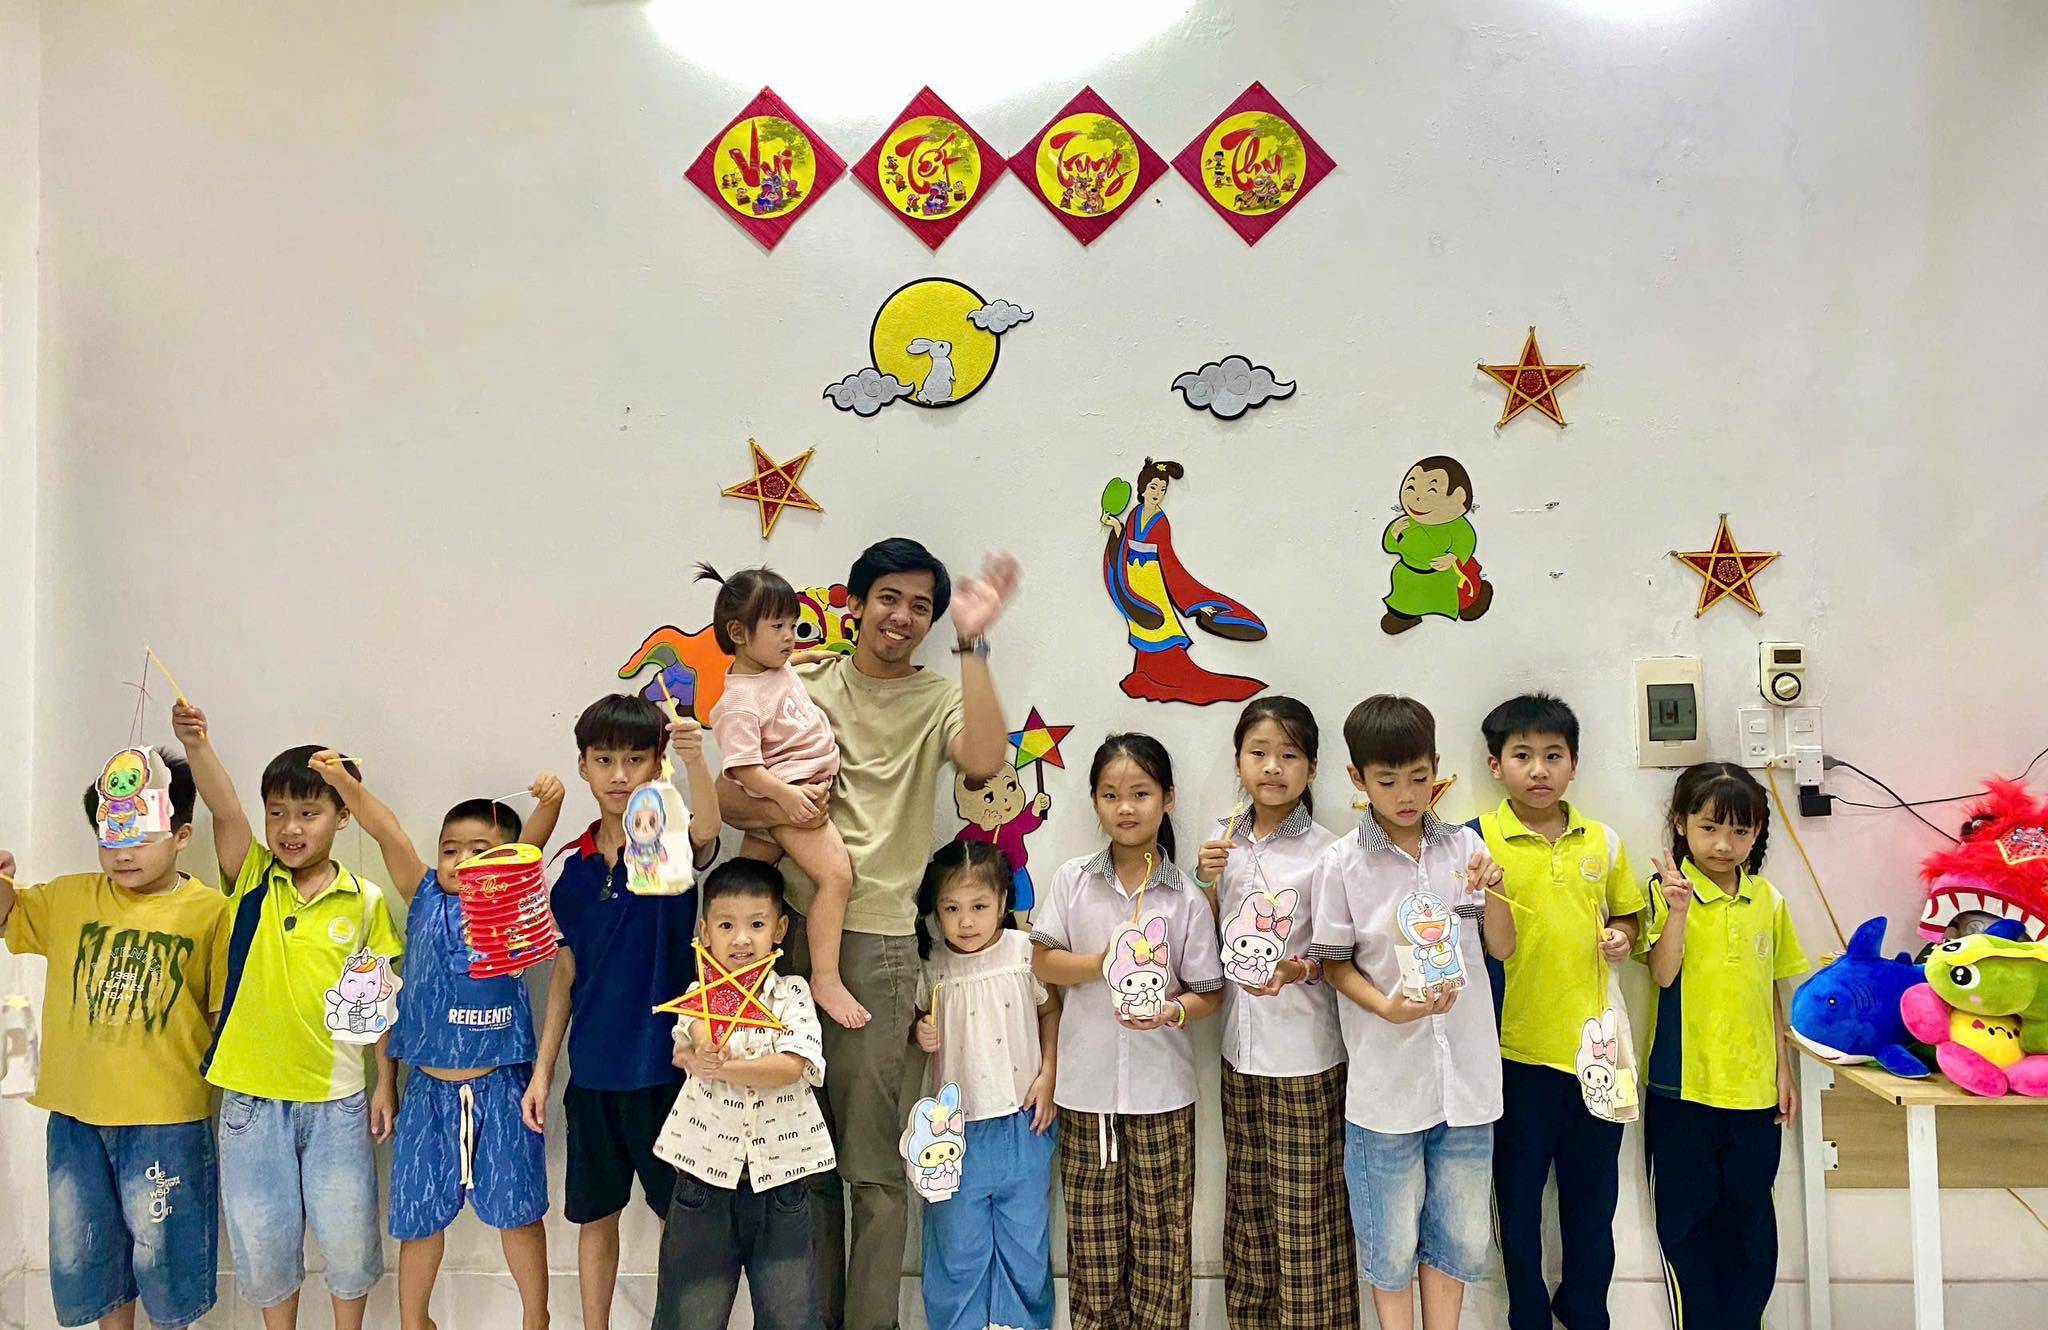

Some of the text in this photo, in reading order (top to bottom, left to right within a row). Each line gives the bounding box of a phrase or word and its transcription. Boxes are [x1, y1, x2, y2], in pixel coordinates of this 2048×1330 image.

[895, 132, 963, 194] Tết
[1050, 131, 1131, 197] Trung
[1220, 128, 1284, 192] Thu
[110, 971, 138, 982] 1988
